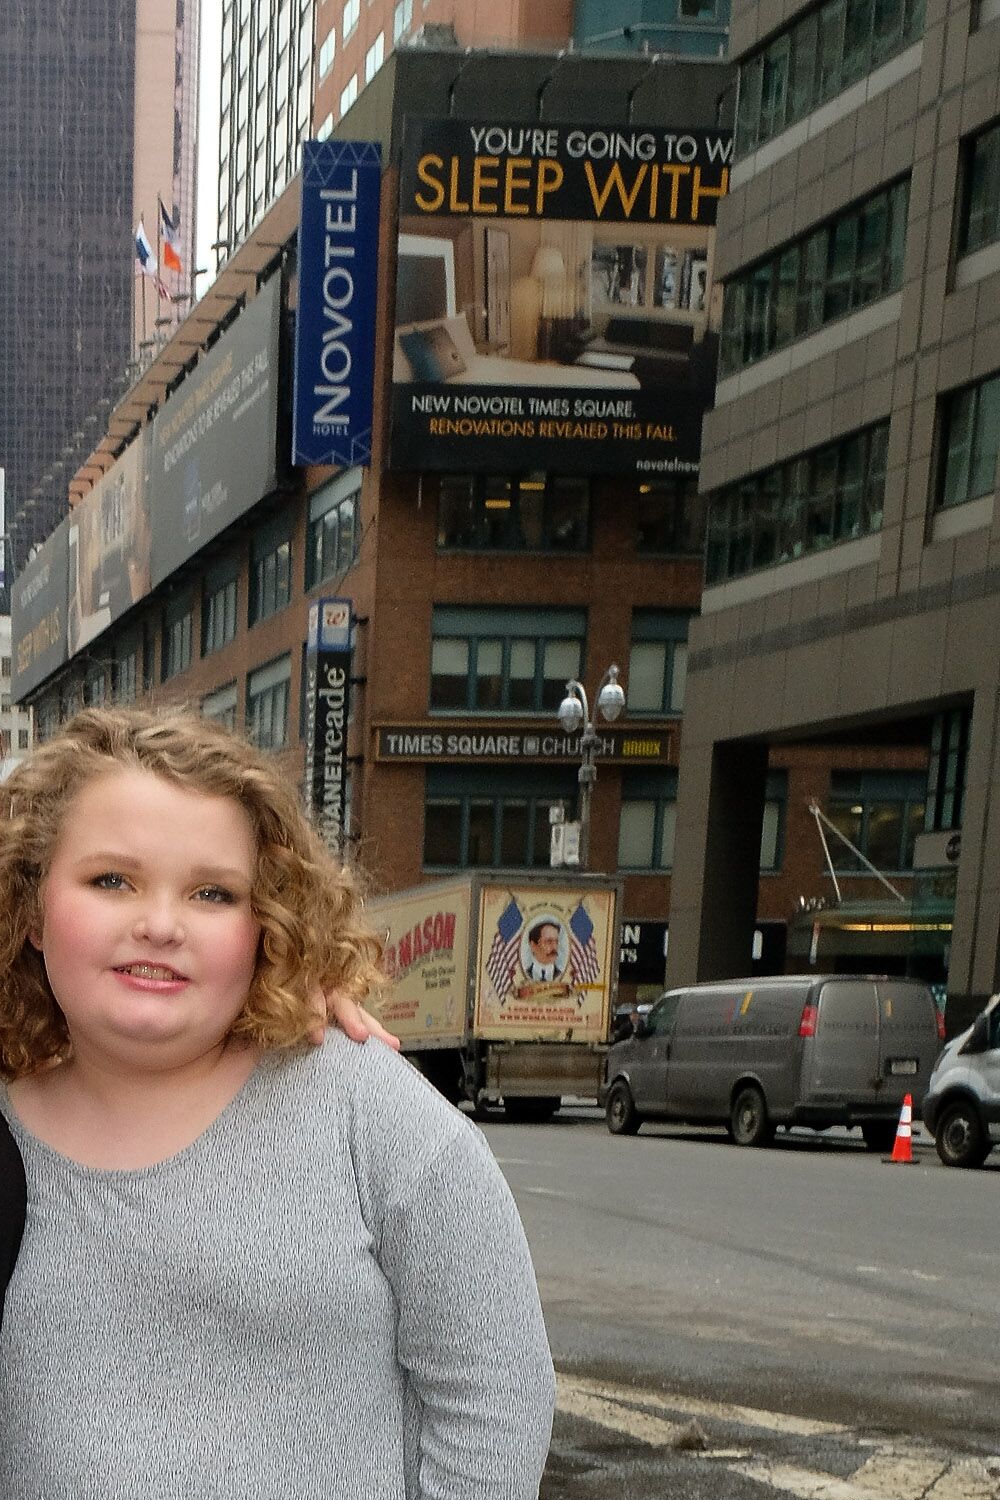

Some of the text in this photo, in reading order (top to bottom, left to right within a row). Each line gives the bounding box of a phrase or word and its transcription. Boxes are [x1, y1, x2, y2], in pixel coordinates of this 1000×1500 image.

[470, 127, 735, 163] YOU'RE GOING TO W
[415, 153, 729, 220] SLEEP WITH
[313, 168, 358, 425] NOVOTEL
[412, 395, 636, 418] NEW NOVOTEL TIMES SQUARE.
[312, 423, 349, 437] HOTEL
[429, 417, 535, 437] RENOVATIONS
[539, 420, 608, 439] REVEALED
[613, 422, 642, 440] THIS
[387, 734, 443, 754] TIMES
[447, 736, 520, 755] SQUARE
